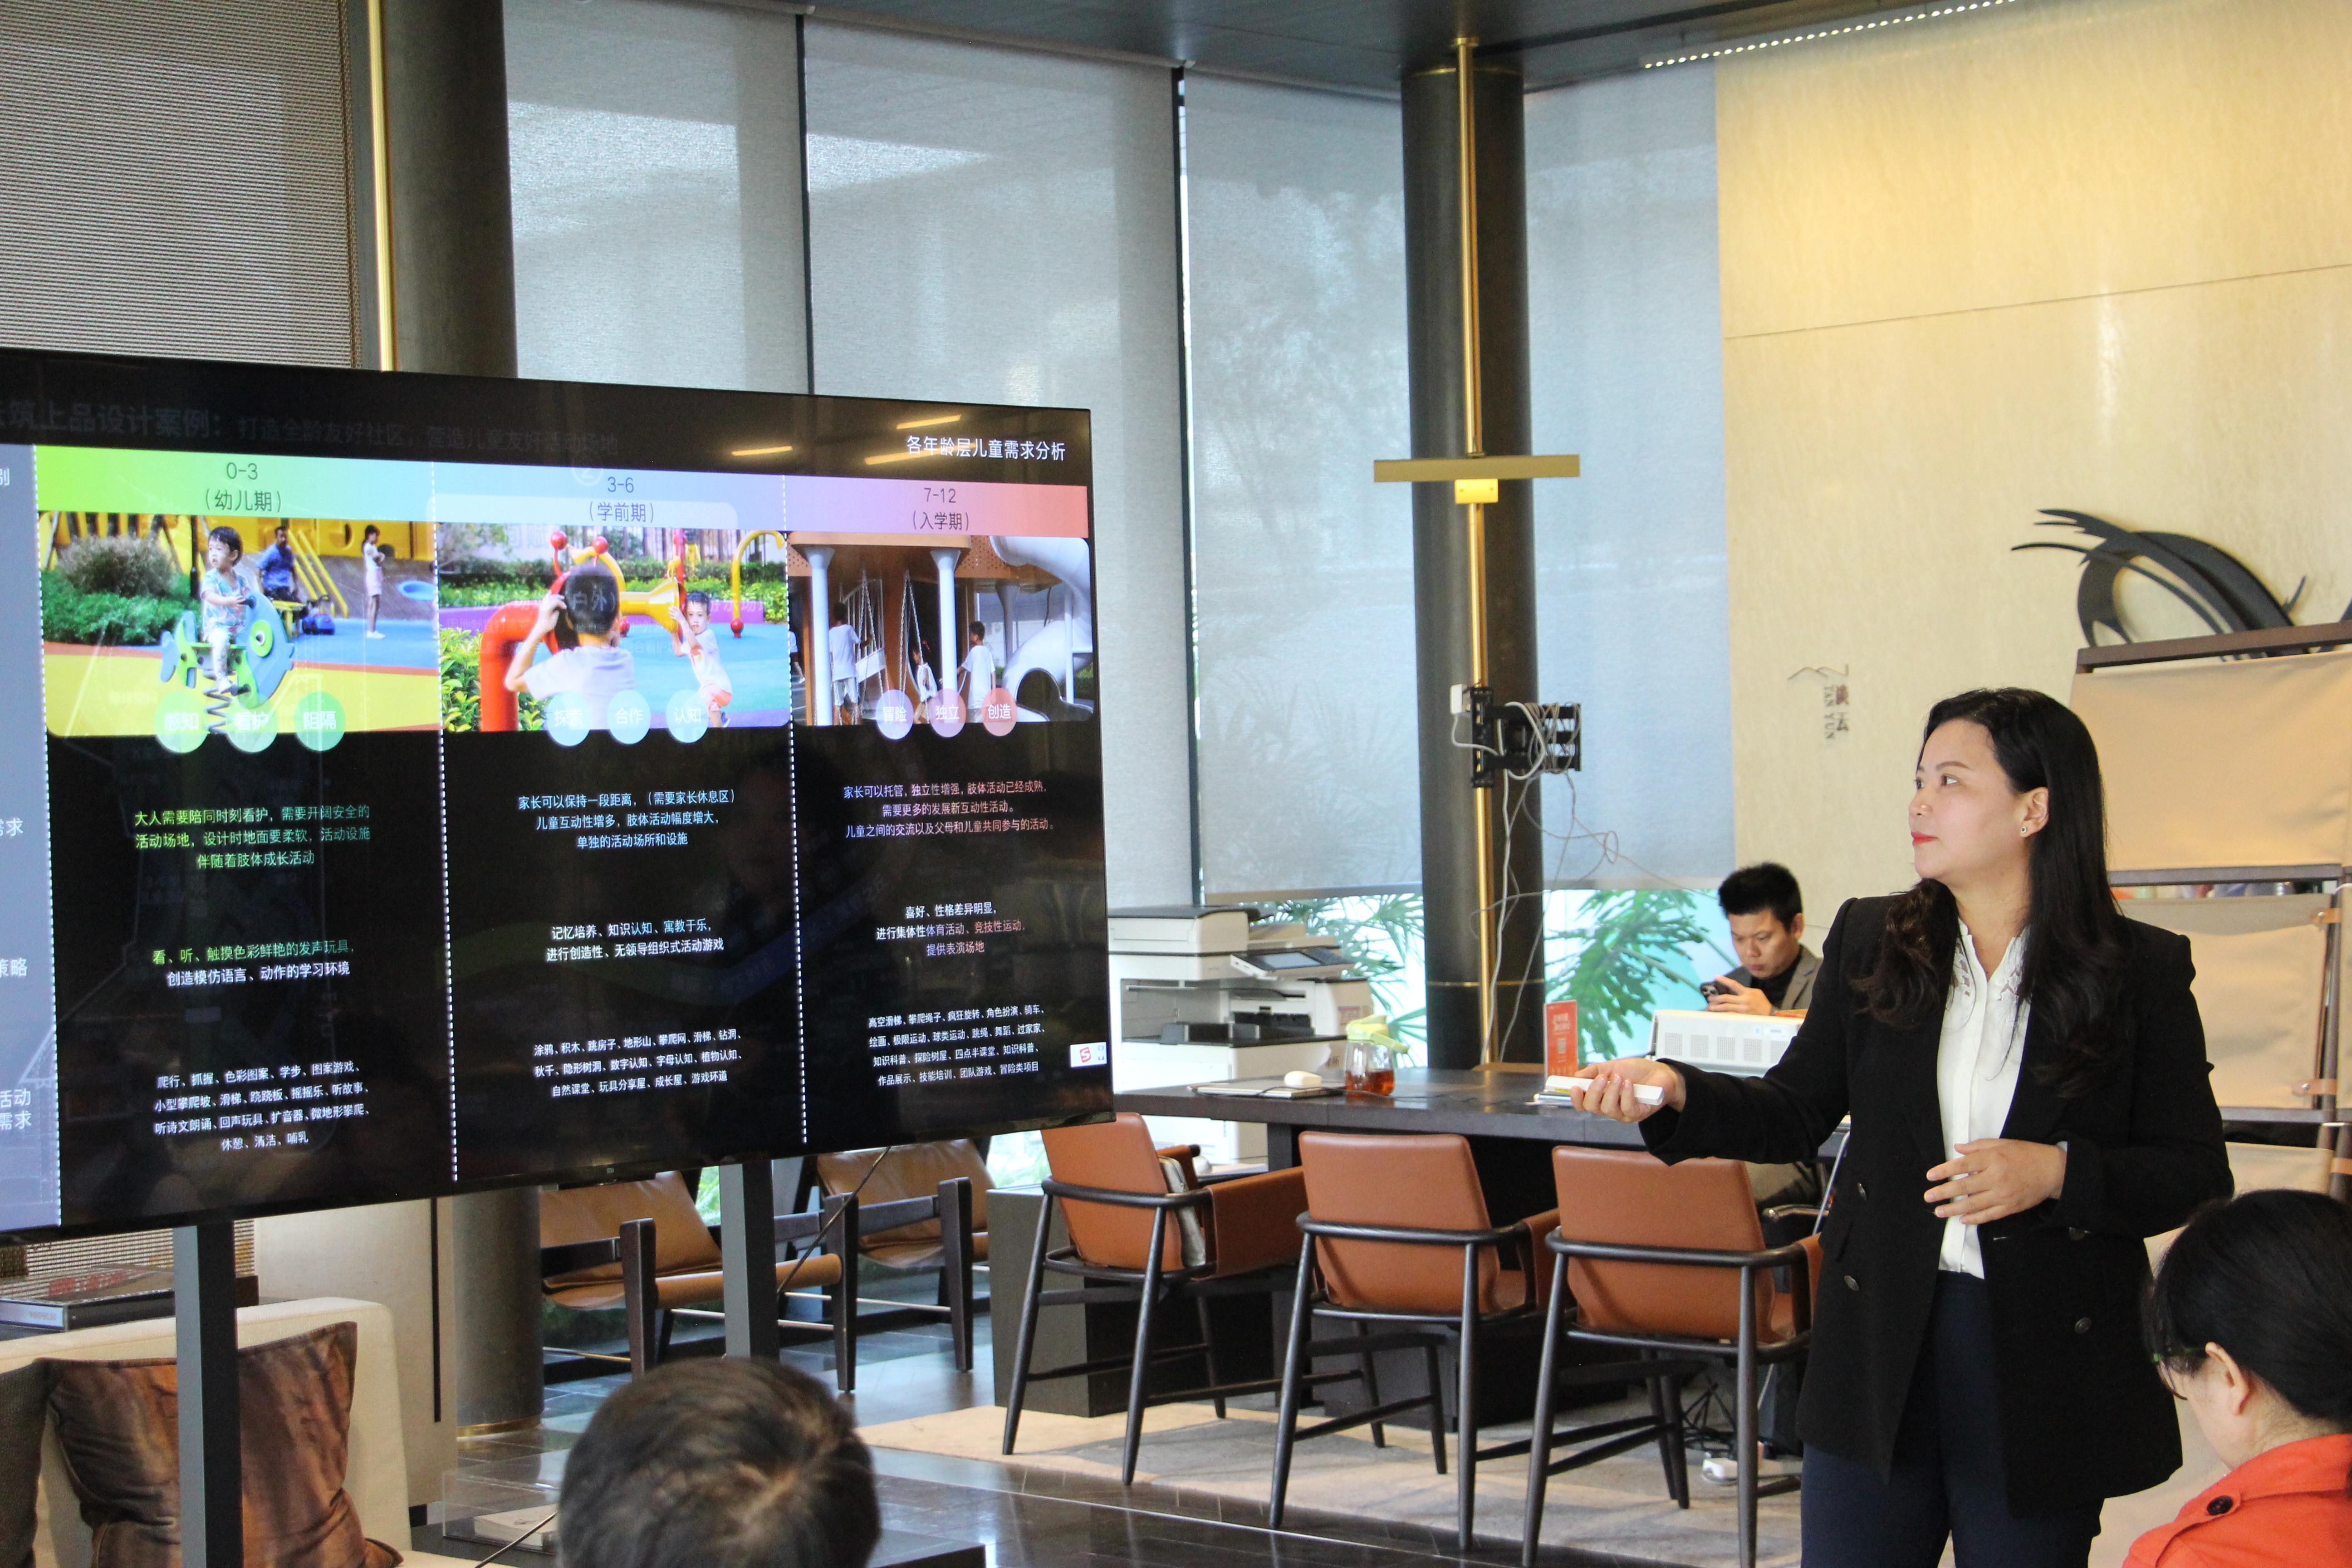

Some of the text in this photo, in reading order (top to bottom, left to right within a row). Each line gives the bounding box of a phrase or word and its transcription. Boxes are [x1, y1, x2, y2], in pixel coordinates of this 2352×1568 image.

[905, 436, 1065, 461] 各年龄层儿童需求分析
[226, 462, 259, 480] 0-3
[608, 477, 634, 493] 3-6
[924, 488, 956, 503] 7-12
[304, 711, 336, 730] 阻隔
[615, 708, 643, 725] 合作
[674, 707, 701, 724] 认知
[883, 706, 907, 722] 冒险
[936, 704, 960, 720] 独立
[988, 704, 1011, 720] 创造
[164, 711, 199, 731] 感知
[0, 817, 23, 836] 求
[578, 832, 688, 848] 单独的活动场所和设施
[197, 850, 314, 868] 伴随着肢体成长活动
[547, 938, 724, 961] 进行创造性、无领导组织式活动游戏
[926, 941, 984, 956] 提供表演场地
[167, 961, 350, 986] 创造模仿语言、动作的学习环境
[221, 1131, 308, 1151] 休憩、清洁、哺乳
